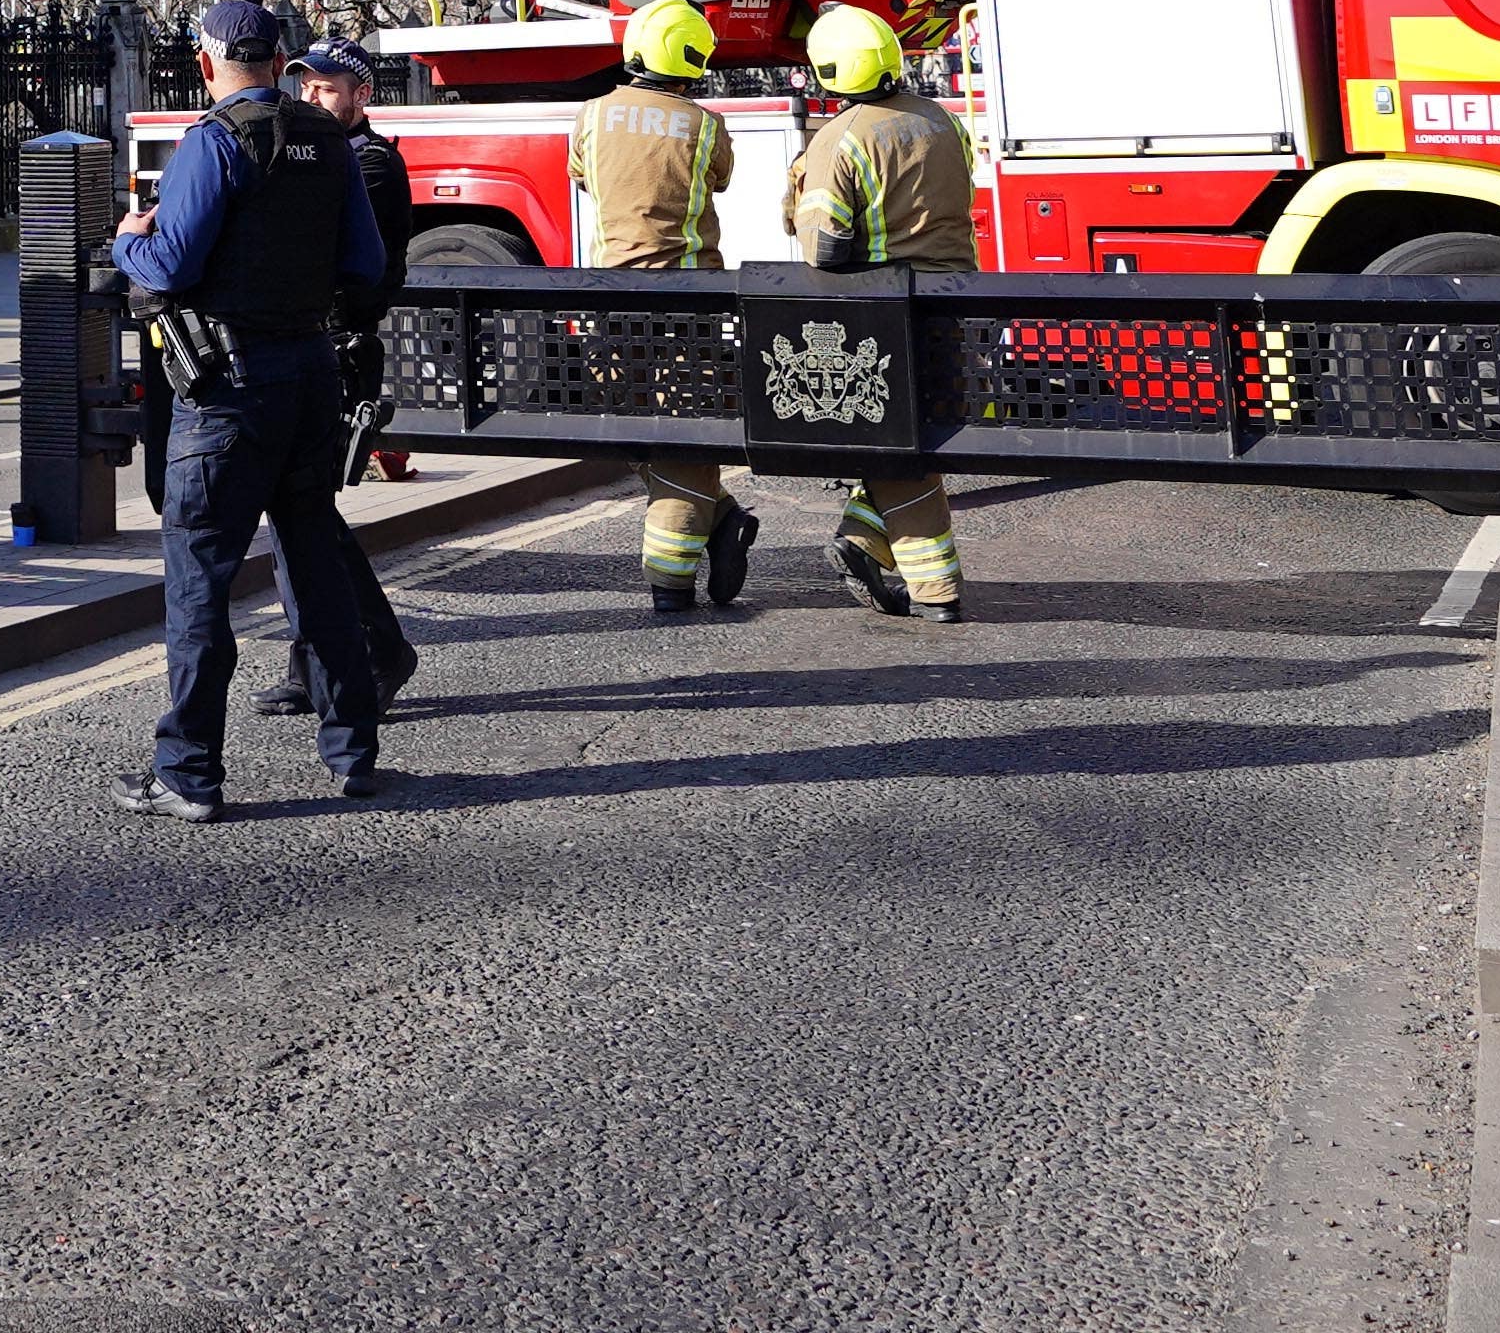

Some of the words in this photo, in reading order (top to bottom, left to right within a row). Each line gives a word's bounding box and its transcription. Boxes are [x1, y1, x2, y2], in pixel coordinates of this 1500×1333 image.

[605, 105, 692, 139] FIRE
[1415, 134, 1460, 144] LONDON
[1461, 135, 1485, 144] FIRE
[286, 145, 317, 160] POLICE
